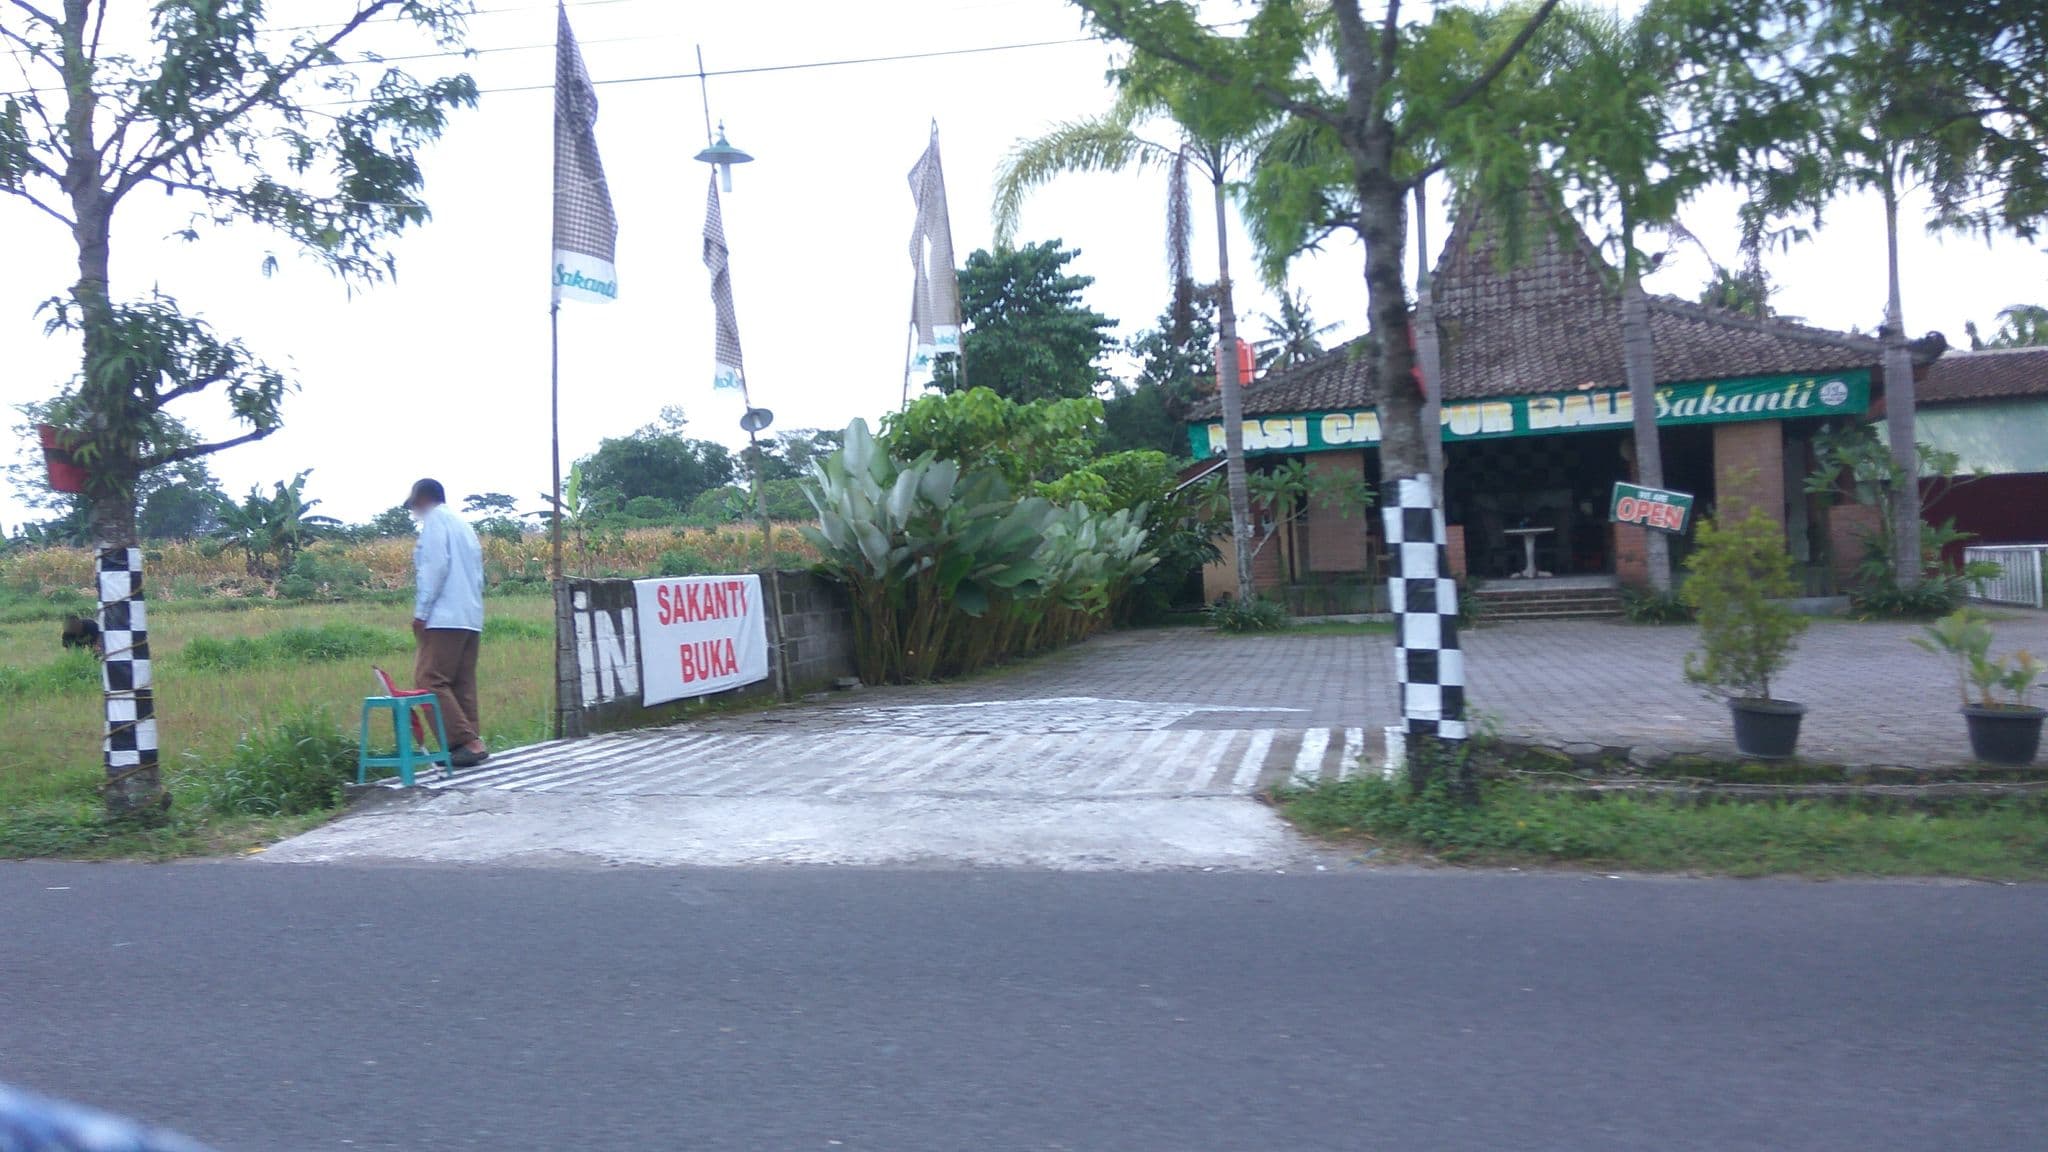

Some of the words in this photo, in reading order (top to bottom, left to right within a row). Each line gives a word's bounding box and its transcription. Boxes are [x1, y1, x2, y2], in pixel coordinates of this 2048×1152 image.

[1655, 379, 1815, 421] Sakanti
[1321, 402, 1514, 445] CAUR
[1616, 496, 1686, 531] OPEN
[657, 581, 748, 626] SAKANTI
[680, 638, 739, 683] BUKA
